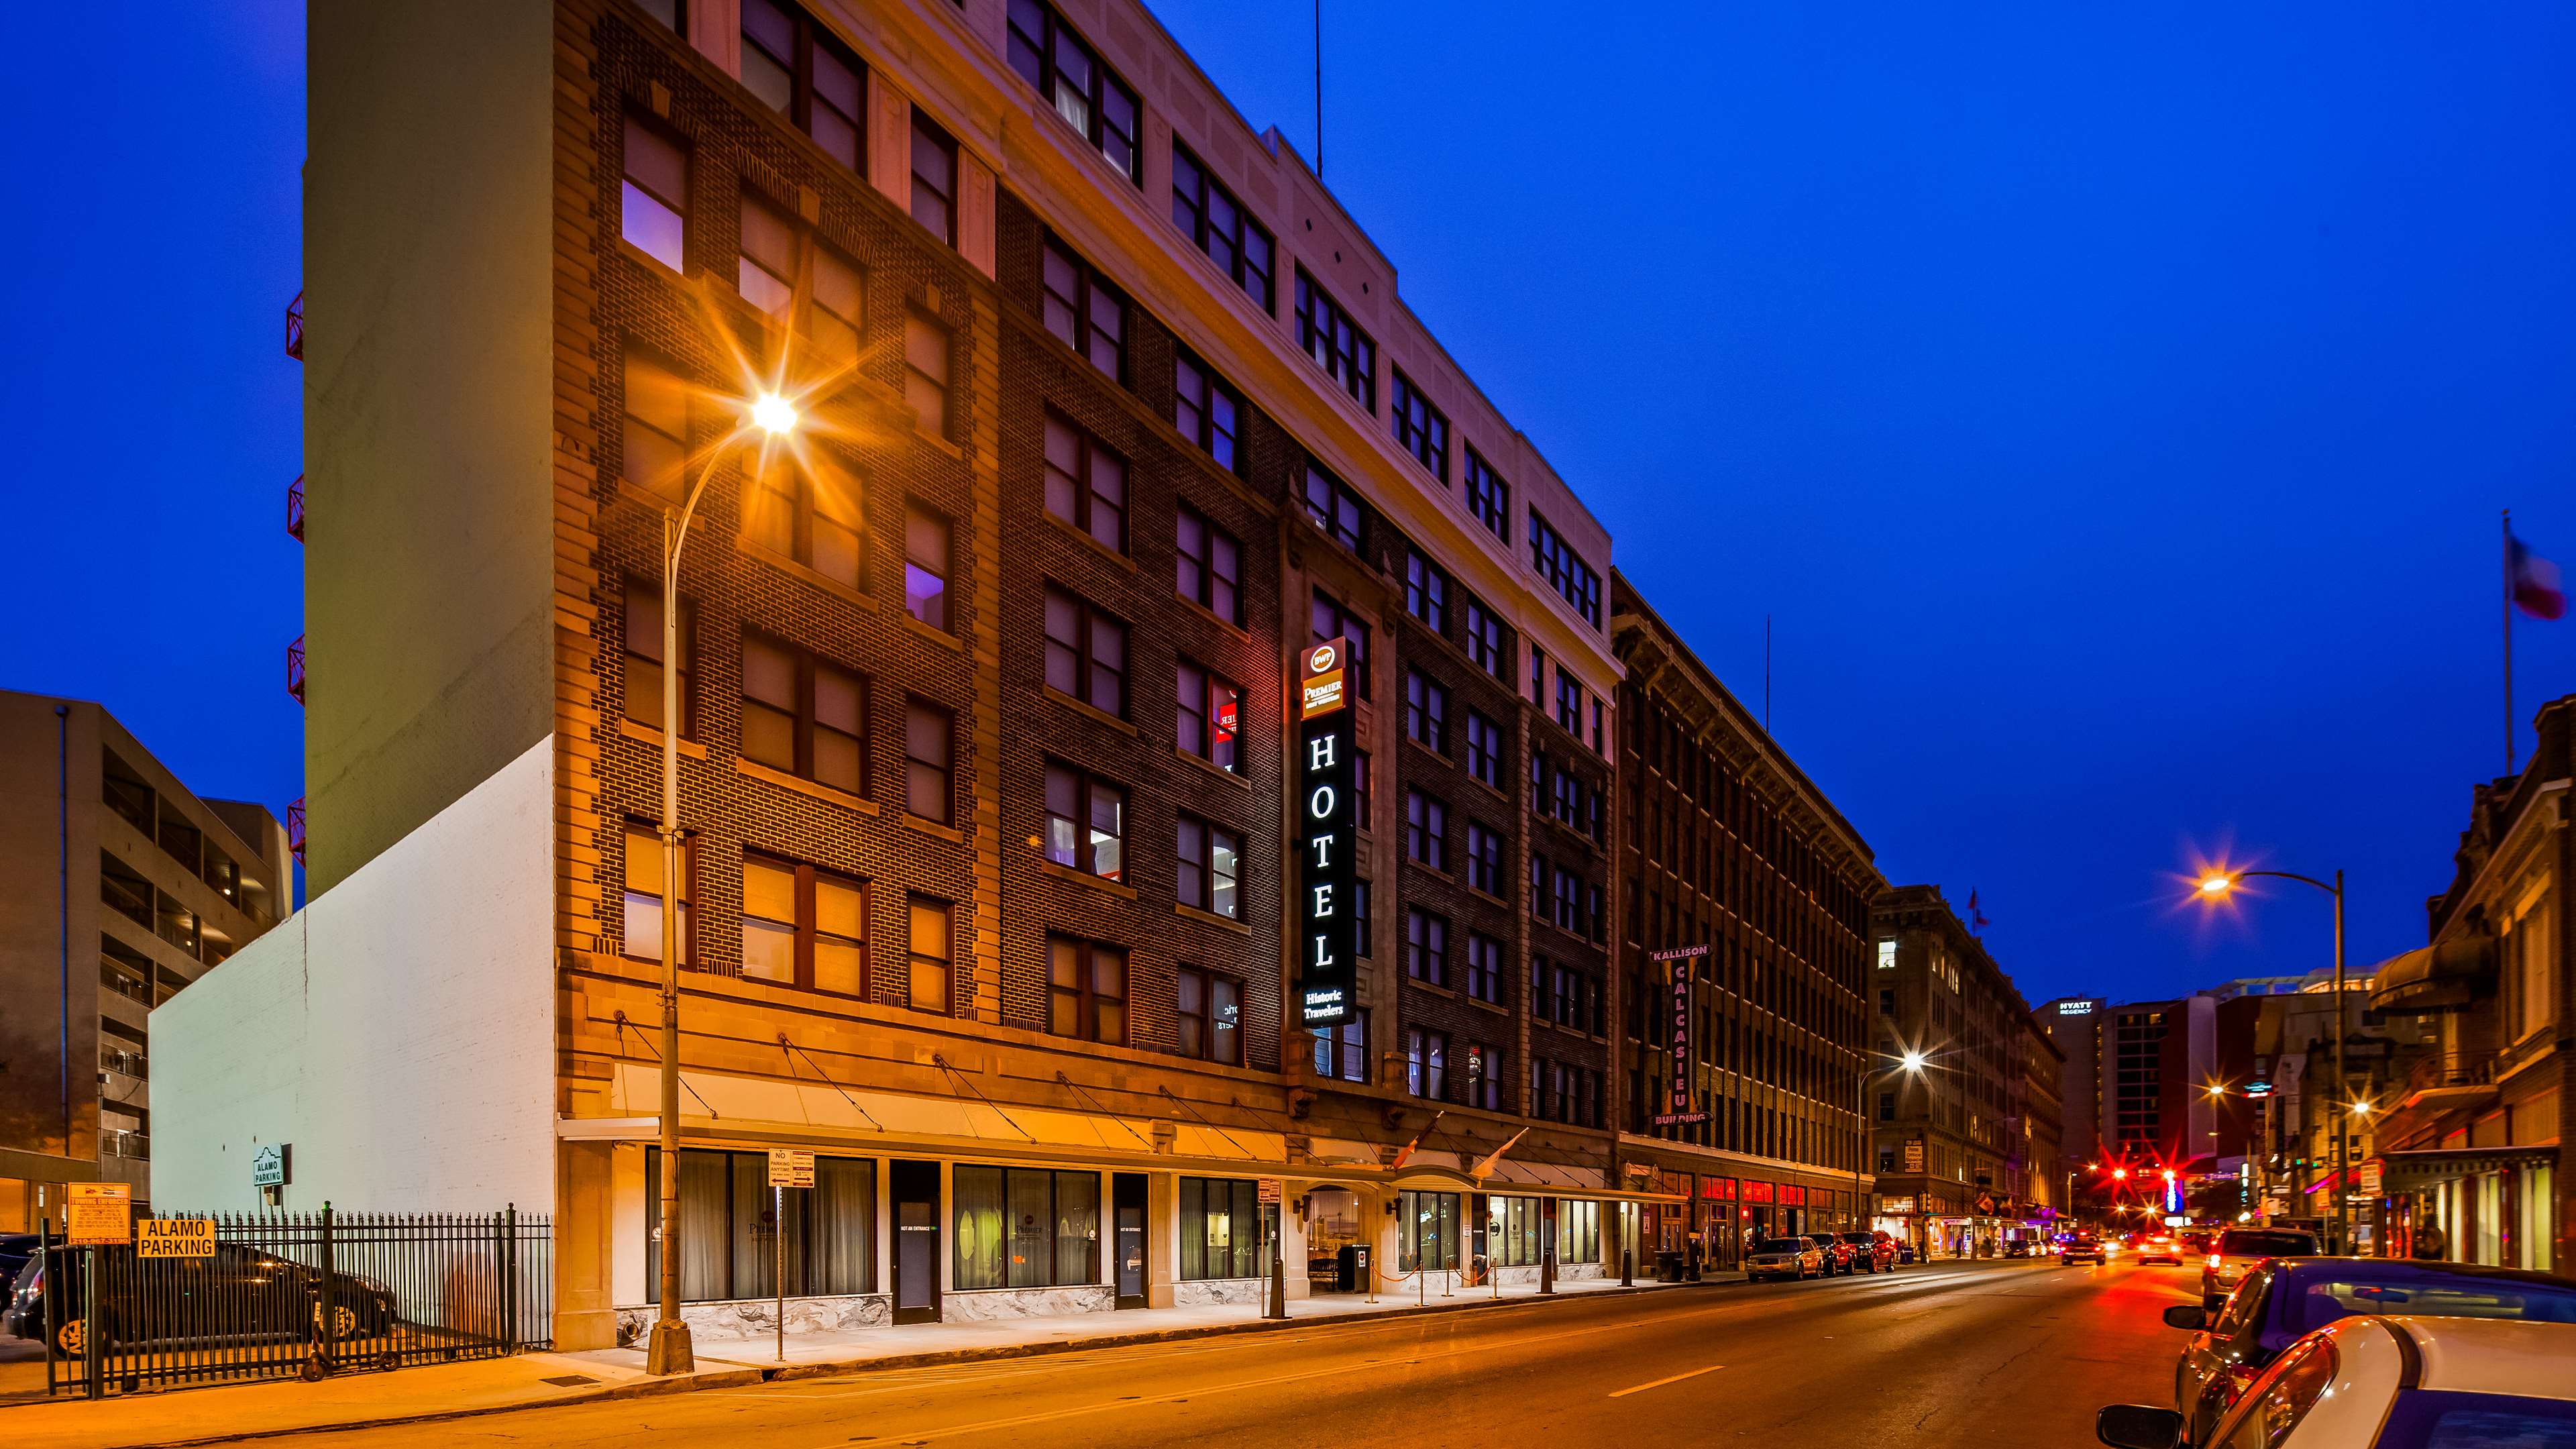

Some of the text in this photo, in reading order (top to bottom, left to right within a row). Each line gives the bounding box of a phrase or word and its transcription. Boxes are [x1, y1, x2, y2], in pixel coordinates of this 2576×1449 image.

[1314, 652, 1332, 666] BWP
[1304, 680, 1342, 701] PREMIER
[1310, 735, 1336, 967] HOTEL
[1654, 946, 1707, 961] KALLISON
[1306, 989, 1342, 1005] Historic
[1304, 1005, 1344, 1020] Travelers
[1674, 966, 1686, 1106] CALCASIEU
[258, 1161, 278, 1172] ALAMO
[256, 1171, 280, 1183] PARKING
[148, 1221, 205, 1236] ALAMO
[1016, 1225, 1042, 1234] PREMIER
[142, 1239, 212, 1255] PARKING
